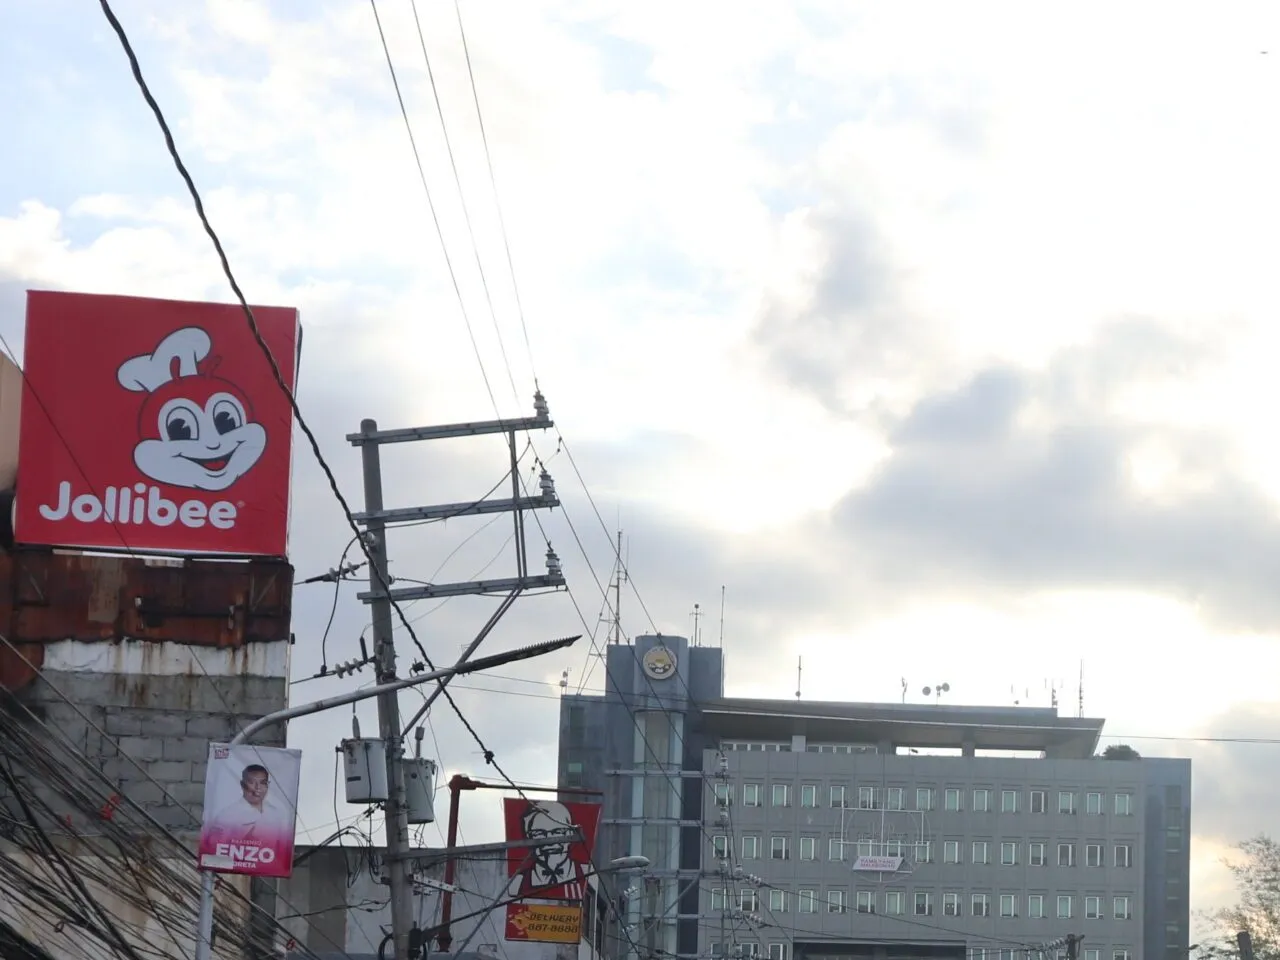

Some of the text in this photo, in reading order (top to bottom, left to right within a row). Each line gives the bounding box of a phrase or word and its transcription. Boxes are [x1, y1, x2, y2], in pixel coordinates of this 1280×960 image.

[39, 481, 238, 529] Jollibee
[215, 843, 275, 864] ENZO
[529, 913, 579, 923] DELIVERY
